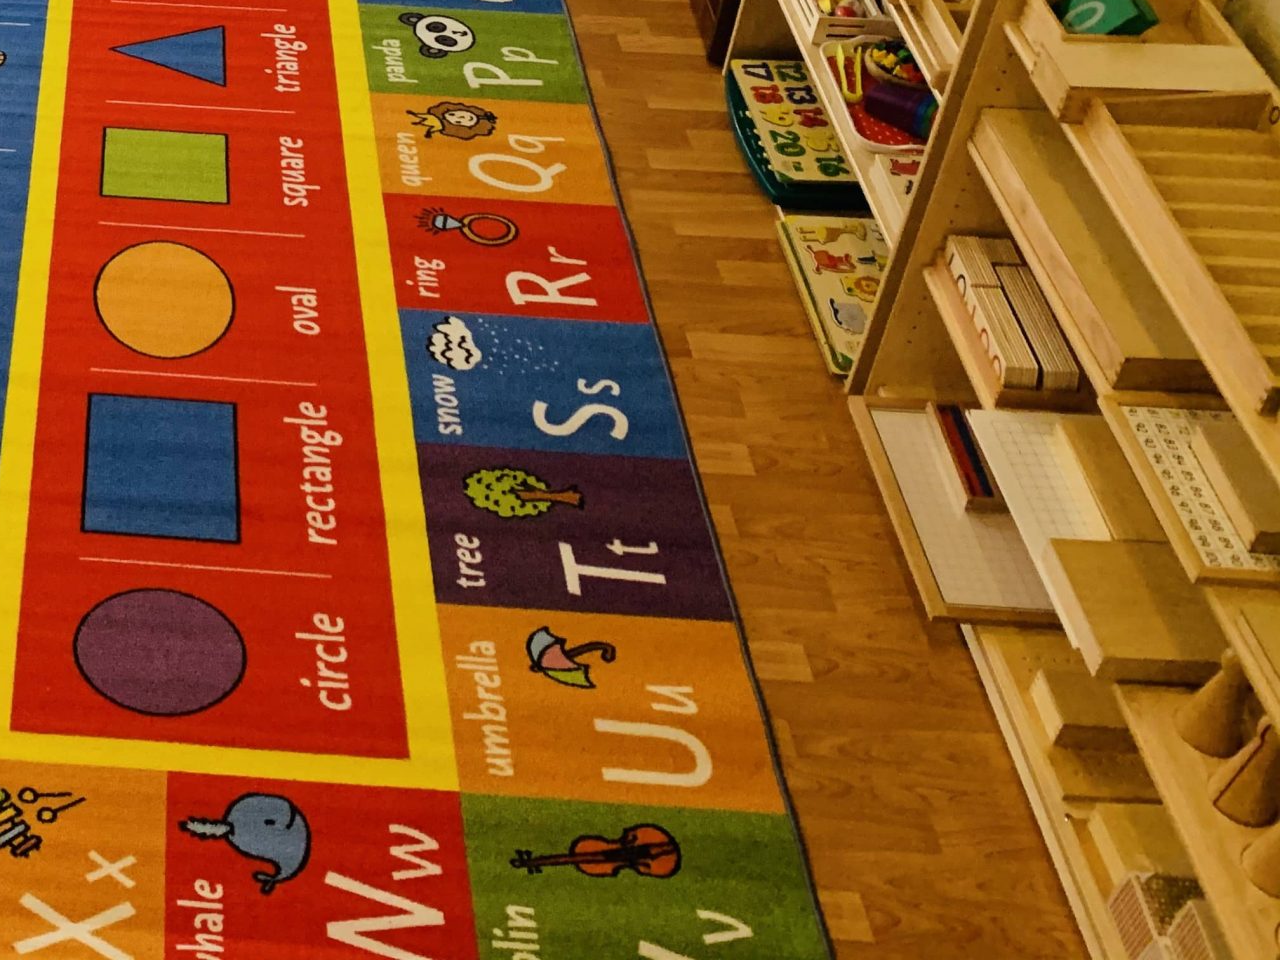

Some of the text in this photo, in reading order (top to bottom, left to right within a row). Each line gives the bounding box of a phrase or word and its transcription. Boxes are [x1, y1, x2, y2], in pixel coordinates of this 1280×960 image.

[271, 24, 309, 93] triangle
[385, 38, 404, 83] panda
[463, 45, 558, 89] Pp
[741, 61, 774, 82] 17
[774, 61, 808, 82] 12
[784, 84, 817, 105] 13
[280, 137, 314, 207] square
[398, 132, 420, 187] queen
[468, 134, 566, 192] Qq
[768, 130, 806, 157] 20
[815, 154, 850, 177] 16
[406, 256, 445, 297] ring
[506, 247, 597, 306] Rr
[275, 286, 320, 335] oval
[432, 374, 462, 435] snow
[533, 378, 628, 440] Ss
[283, 402, 343, 544] rectangle
[455, 534, 485, 587] tree
[559, 539, 666, 595] Tt
[294, 612, 352, 711] circle
[456, 641, 513, 776] umbrella
[594, 685, 712, 787] Uu
[13, 851, 135, 960] Xx
[176, 879, 224, 960] hale
